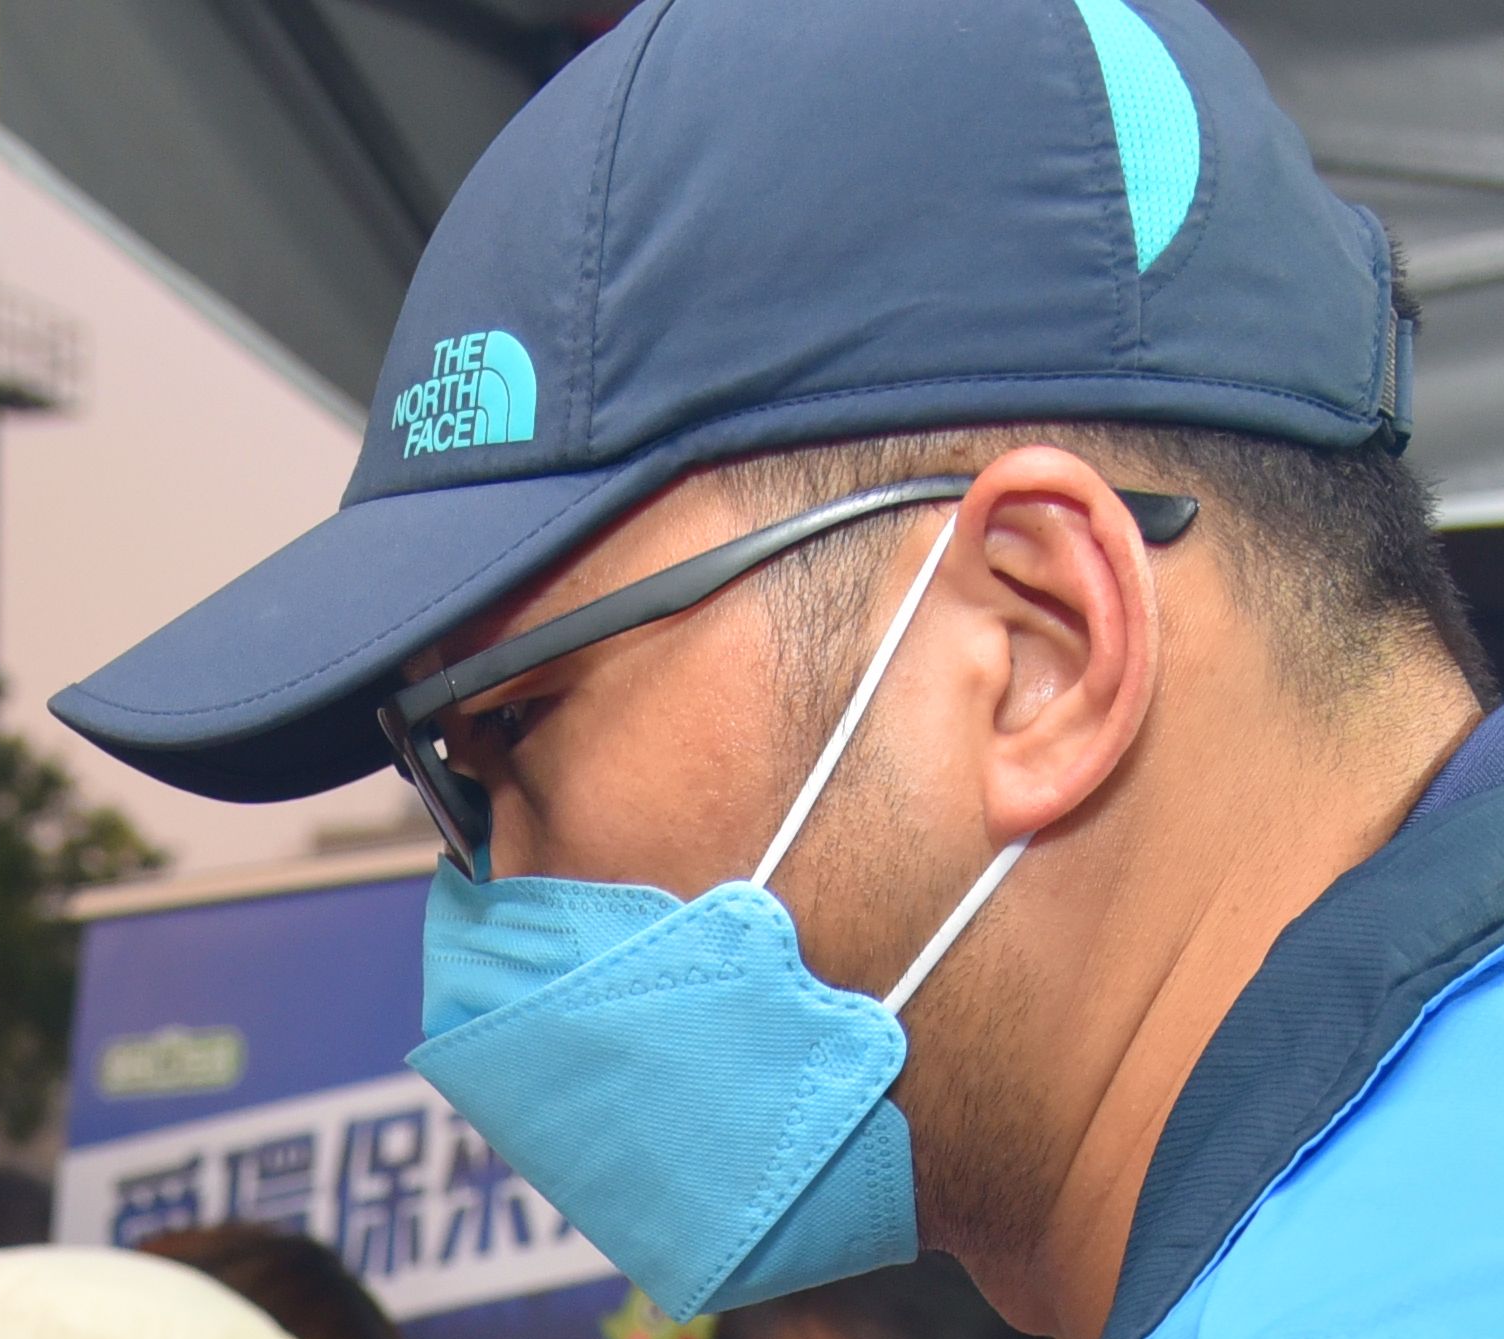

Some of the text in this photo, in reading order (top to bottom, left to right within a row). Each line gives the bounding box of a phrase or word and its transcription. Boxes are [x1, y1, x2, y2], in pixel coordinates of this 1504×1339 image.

[432, 332, 487, 378] THE
[391, 370, 480, 430] NORTH
[403, 409, 475, 460] FACE
